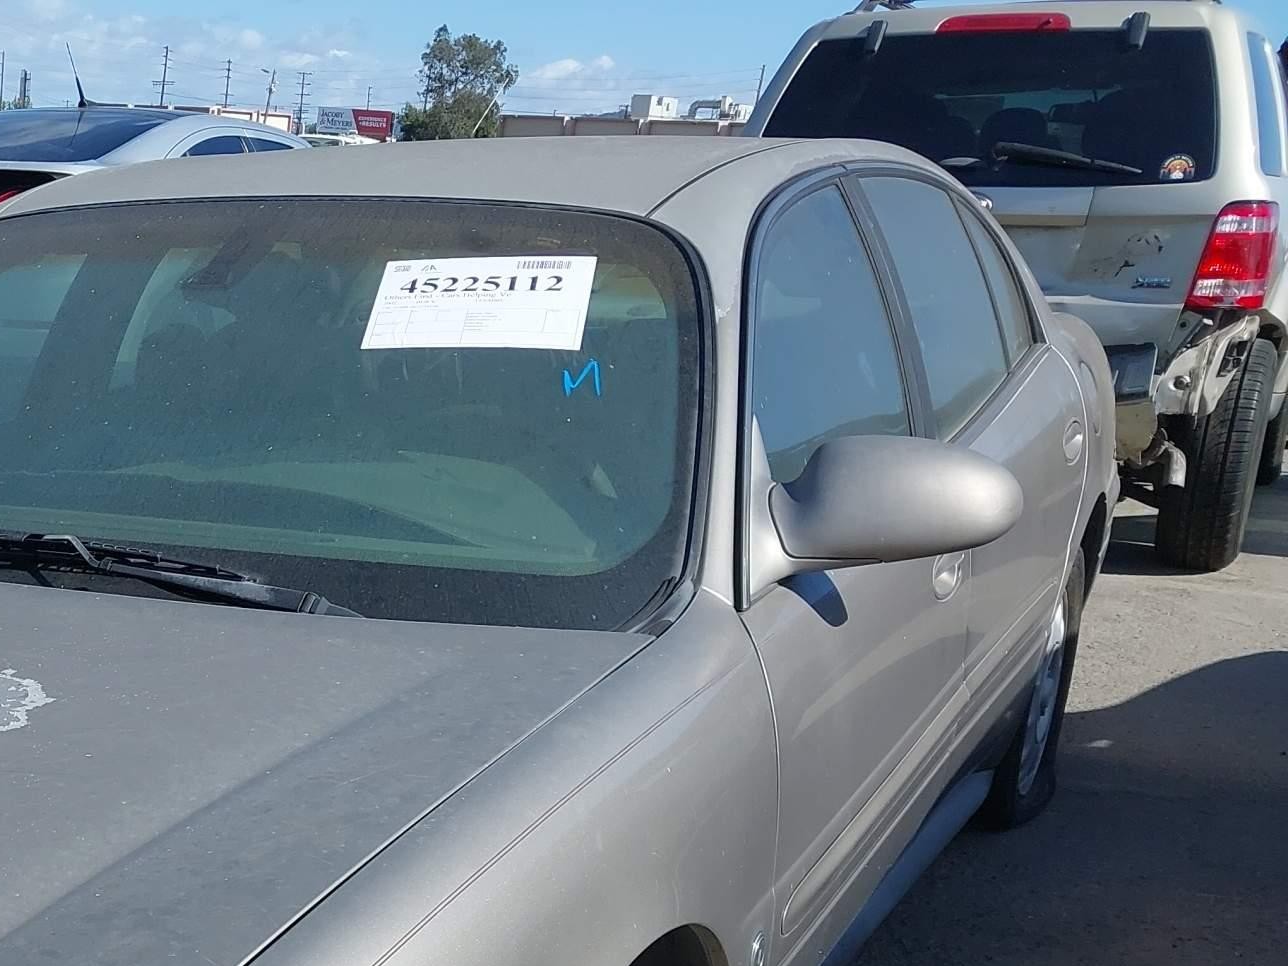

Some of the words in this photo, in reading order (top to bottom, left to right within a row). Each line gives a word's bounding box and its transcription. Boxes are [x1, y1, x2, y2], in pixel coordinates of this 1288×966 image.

[320, 109, 344, 119] JACOBY
[327, 118, 352, 127] MEYERS
[400, 275, 564, 294] 45225112
[563, 358, 600, 397] M
